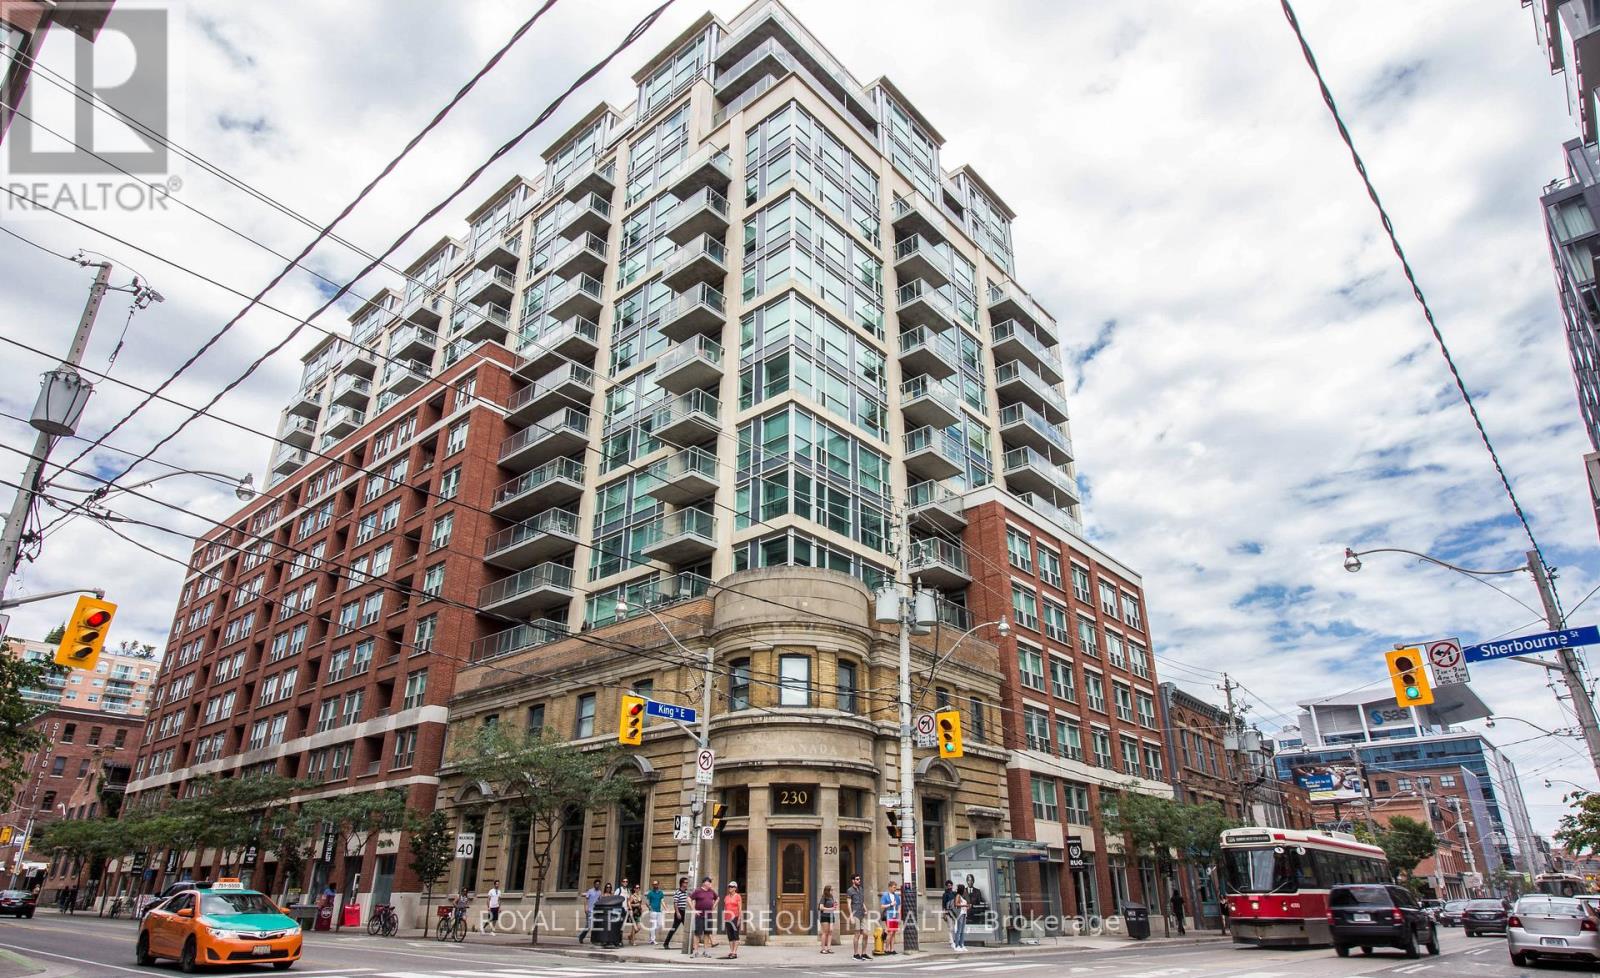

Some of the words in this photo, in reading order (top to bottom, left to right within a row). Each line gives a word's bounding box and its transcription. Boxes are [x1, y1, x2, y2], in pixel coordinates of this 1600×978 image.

[1480, 634, 1568, 657] Sherbourne
[1569, 630, 1579, 638] St
[658, 705, 674, 718] King
[680, 709, 685, 718] E
[1382, 709, 1409, 722] sas
[32, 771, 44, 802] CITY
[780, 790, 808, 805] 230
[457, 843, 473, 855] 40
[823, 845, 838, 855] 230
